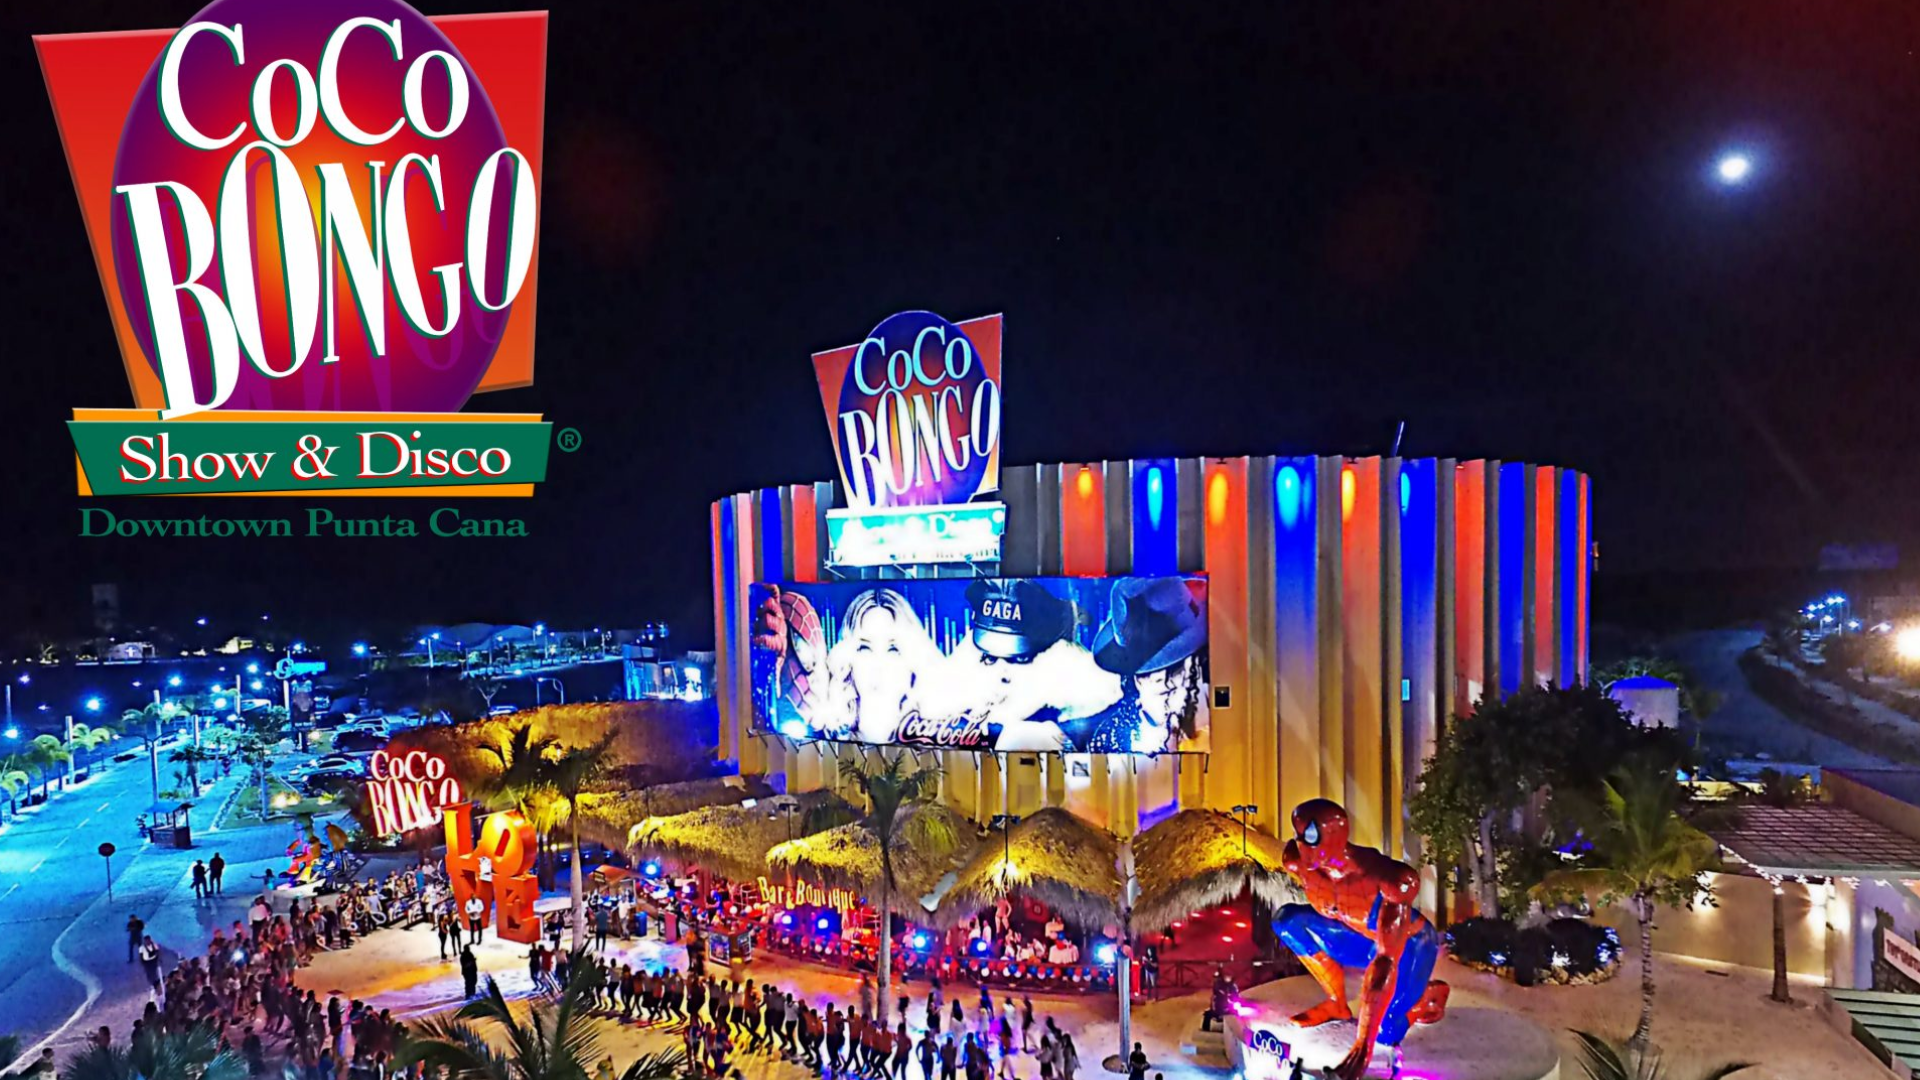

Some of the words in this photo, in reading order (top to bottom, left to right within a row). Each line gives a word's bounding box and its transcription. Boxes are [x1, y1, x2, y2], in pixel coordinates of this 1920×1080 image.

[839, 379, 1000, 508] BONGO
[982, 599, 1022, 621] GAGA
[366, 777, 460, 838] BONGO
[757, 876, 784, 904] Bar
